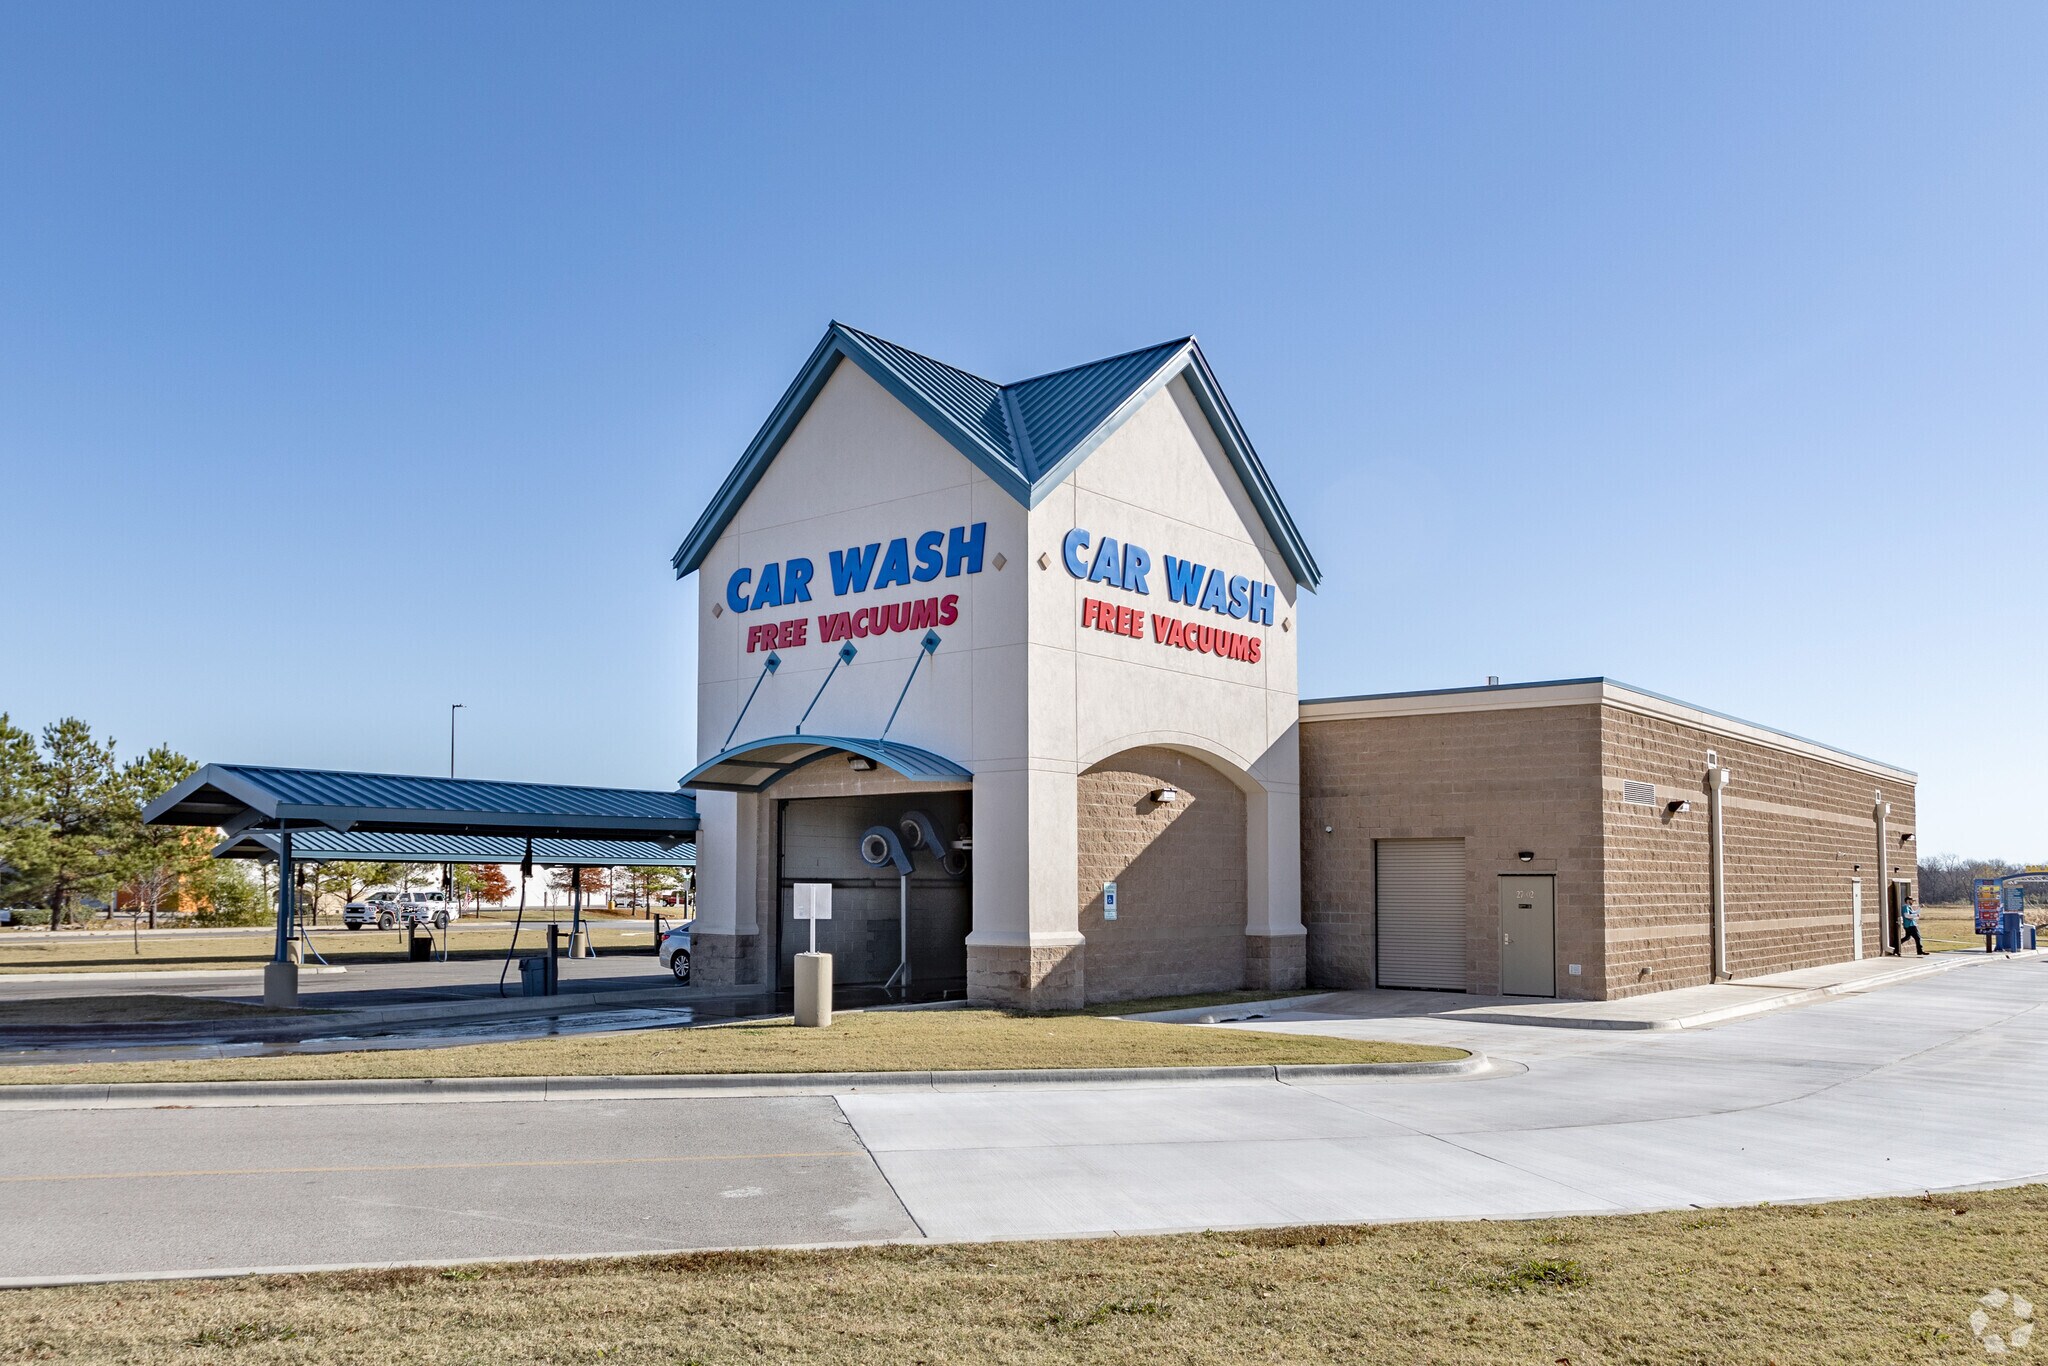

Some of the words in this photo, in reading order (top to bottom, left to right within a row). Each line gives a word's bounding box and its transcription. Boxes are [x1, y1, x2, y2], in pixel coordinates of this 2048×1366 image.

[727, 557, 814, 614] CAR
[828, 522, 987, 597] WASH
[1062, 527, 1151, 595] CAR
[1164, 554, 1275, 627] WASH
[746, 618, 808, 653] FREE
[818, 594, 960, 643] VACUUMS
[1082, 597, 1145, 639] FREE
[1152, 613, 1262, 664] VACUUMS
